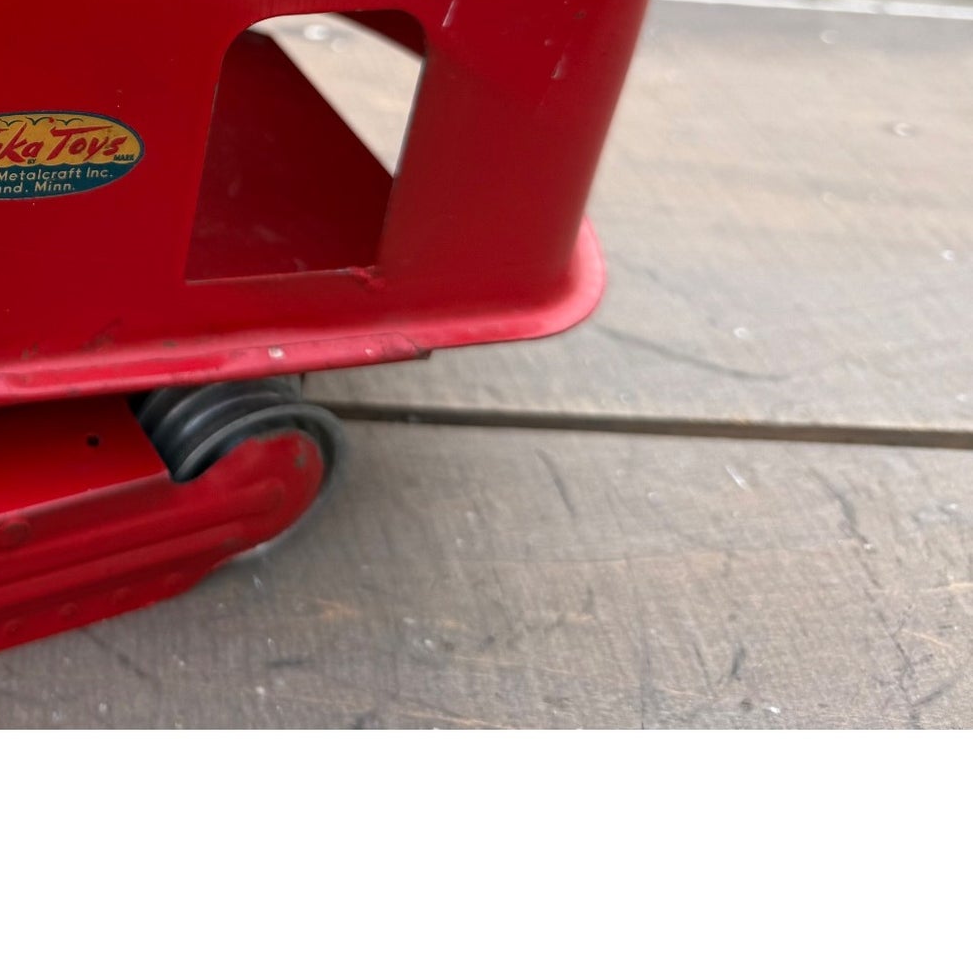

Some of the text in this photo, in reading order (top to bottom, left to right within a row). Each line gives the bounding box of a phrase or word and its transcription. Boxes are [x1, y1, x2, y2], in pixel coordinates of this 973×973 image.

[46, 125, 127, 162] Toys
[86, 167, 113, 178] Inc.
[34, 180, 75, 193] Minn.
